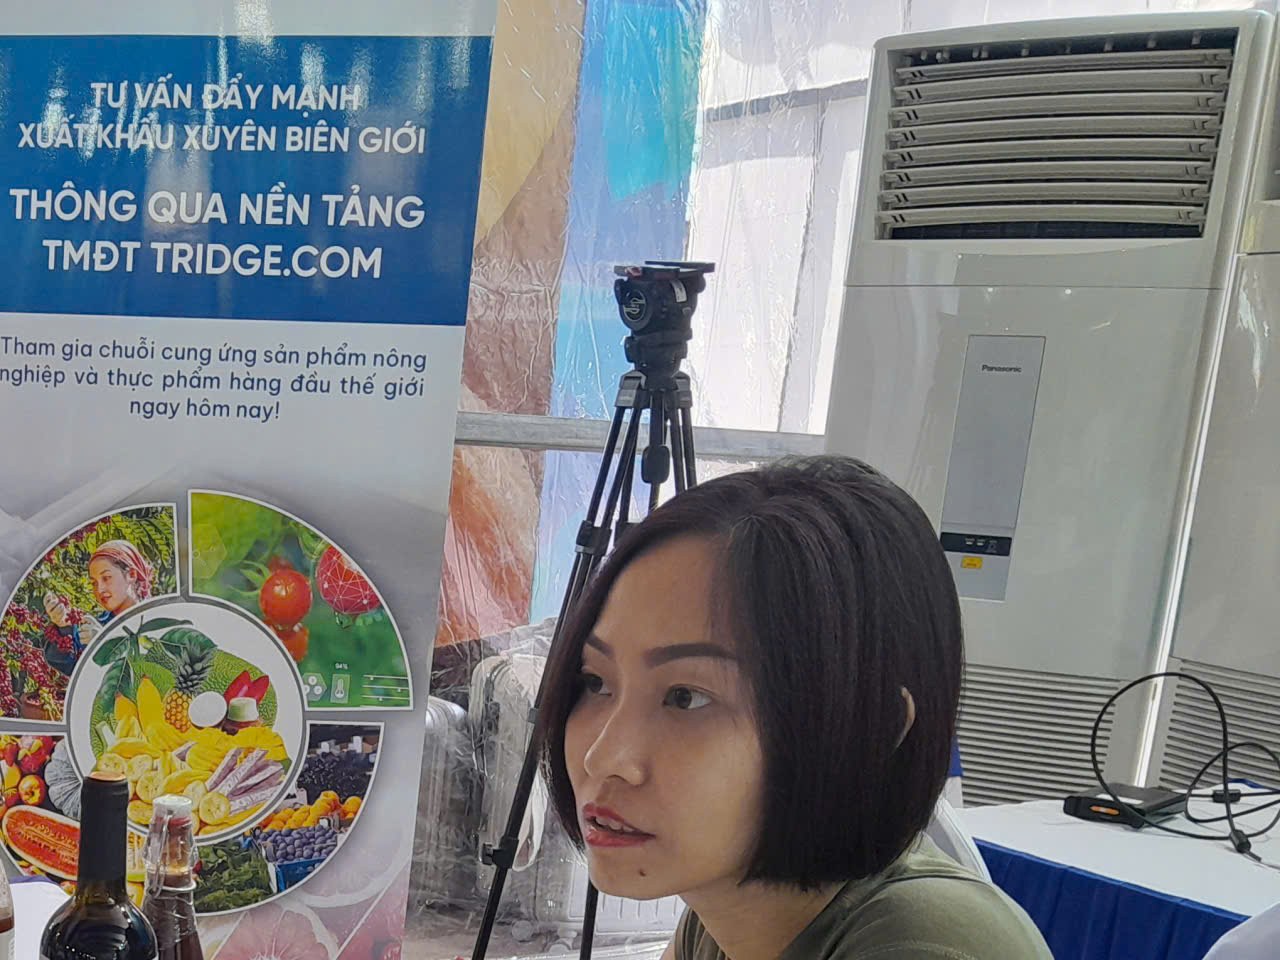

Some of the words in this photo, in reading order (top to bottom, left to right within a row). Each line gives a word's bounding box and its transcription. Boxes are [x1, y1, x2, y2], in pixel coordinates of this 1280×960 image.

[90, 80, 128, 108] TƯ
[135, 73, 192, 109] VẤN
[201, 73, 264, 110] ĐẨY
[272, 83, 361, 118] MẠNH
[18, 113, 88, 149] XUẤT
[97, 112, 174, 150] KHẨU
[182, 119, 277, 151] XUYÊN
[285, 119, 349, 152] BIÊN
[358, 120, 425, 153] GIỚI
[9, 180, 137, 222] THÔNG
[148, 190, 228, 224] QUA
[239, 181, 310, 225] NỀN
[322, 184, 425, 228] TẢNG
[42, 239, 141, 272] TMĐT
[151, 242, 382, 279] TRIDGE.COM
[1, 336, 55, 356] Tham
[61, 339, 92, 361] gia
[99, 336, 155, 359] chuỗi
[161, 345, 212, 366] cung
[218, 342, 257, 367] ứng
[264, 343, 300, 364] sản
[306, 342, 366, 368] phẩm
[373, 348, 427, 373] nông
[982, 364, 1022, 372] Panasonic
[0, 364, 65, 388] nghiệp
[75, 366, 98, 385] và
[107, 368, 153, 391] thực
[162, 366, 220, 392] phẩm
[230, 371, 281, 396] hàng
[290, 371, 330, 393] đầu
[340, 372, 376, 395] thế
[384, 376, 424, 400] giới
[130, 400, 180, 419] ngay
[186, 398, 230, 416] hôm
[236, 401, 280, 423] nay!
